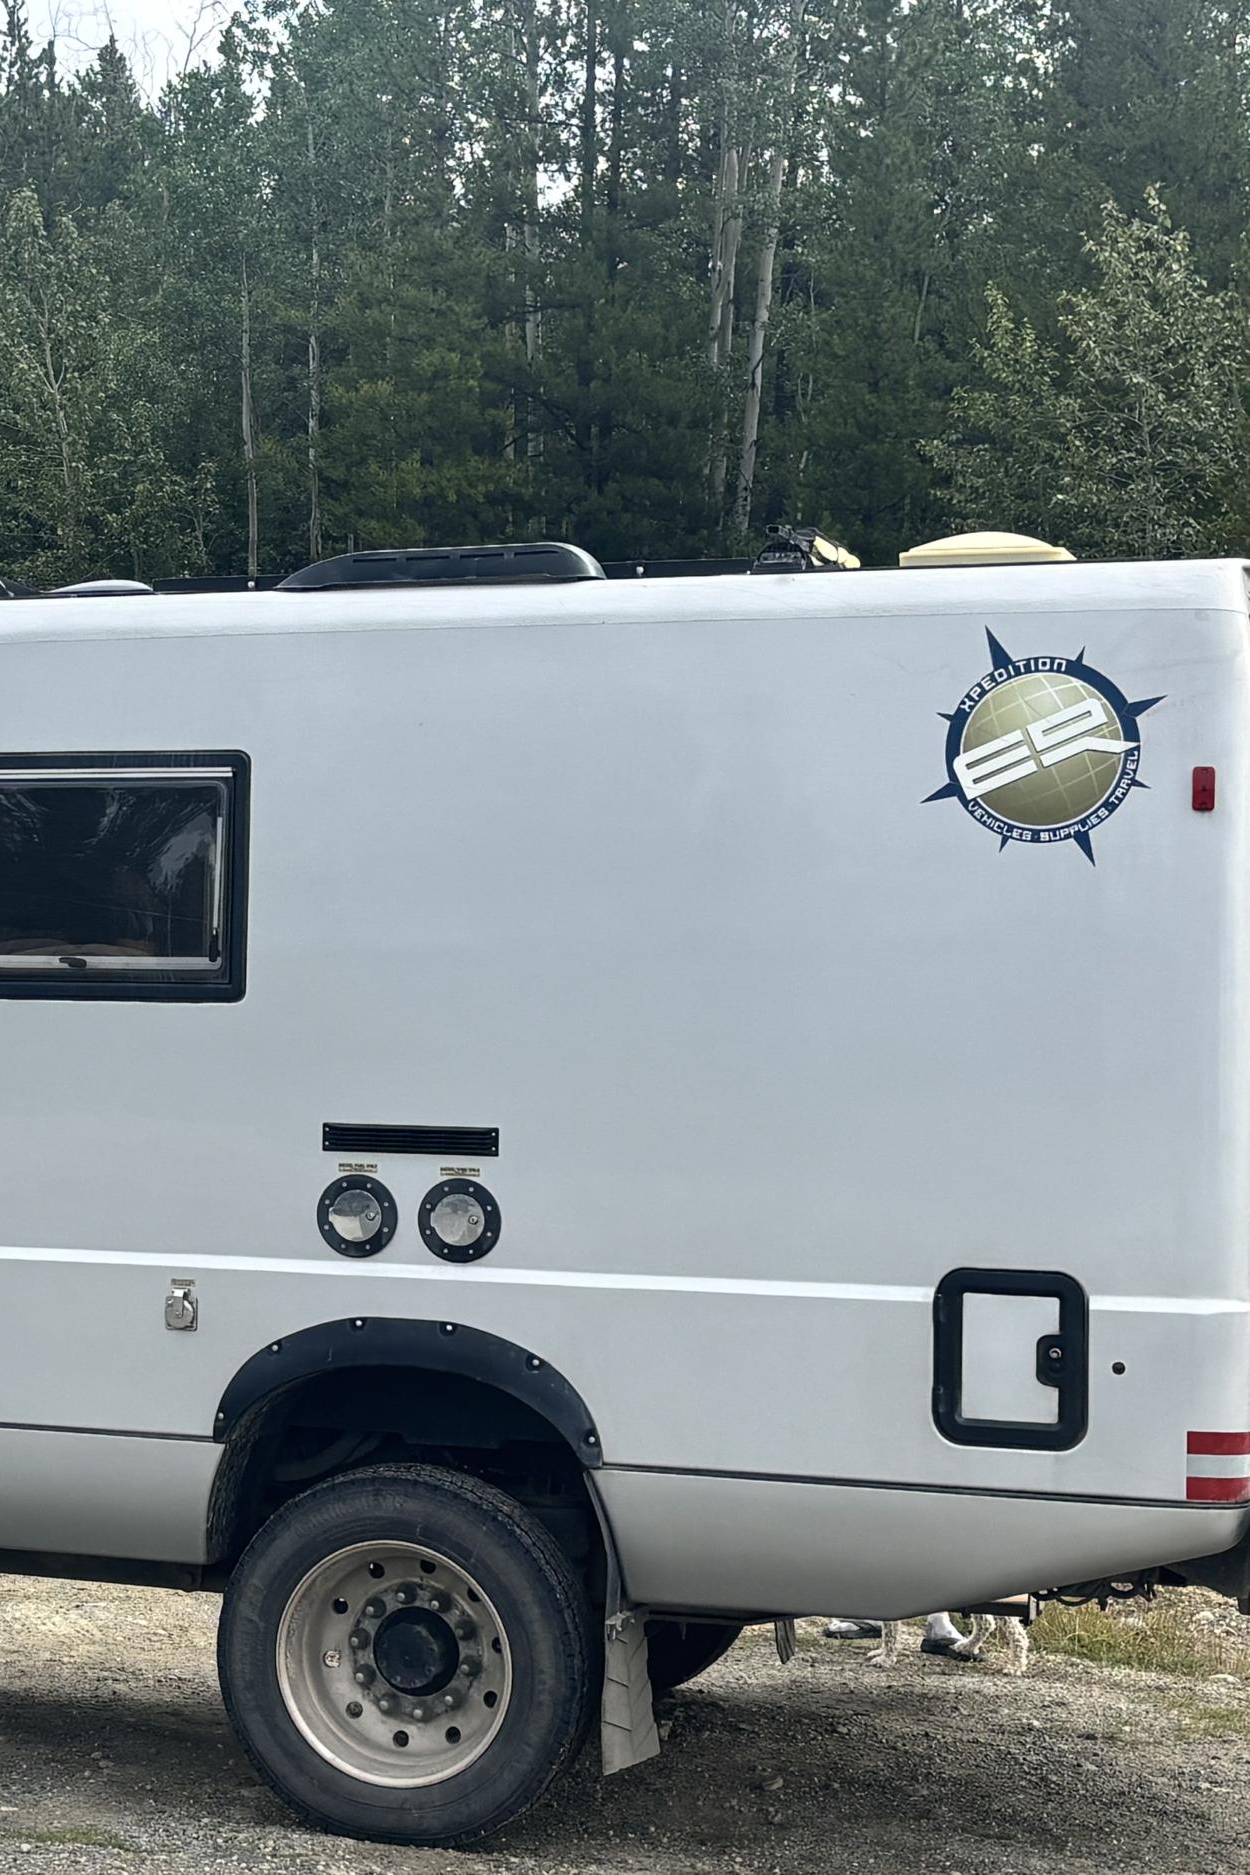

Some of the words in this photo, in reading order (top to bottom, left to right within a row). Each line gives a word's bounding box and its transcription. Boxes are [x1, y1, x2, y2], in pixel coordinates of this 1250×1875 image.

[959, 658, 1067, 712] XPEDITION
[967, 801, 1033, 841] VEHICLES
[1039, 806, 1110, 842] SUPPLIES
